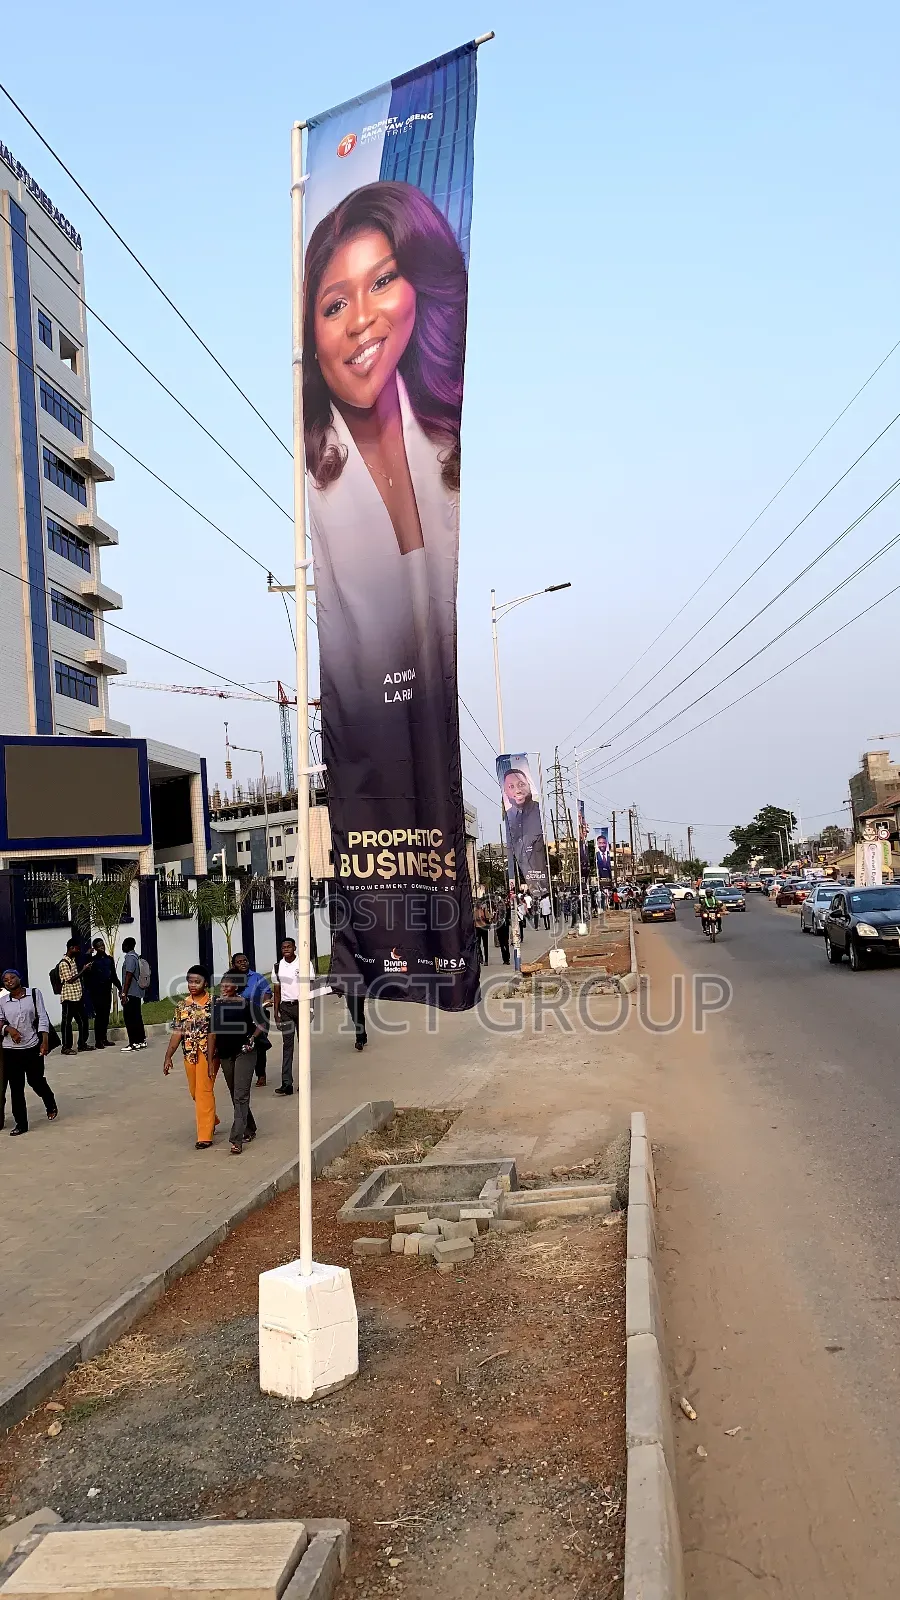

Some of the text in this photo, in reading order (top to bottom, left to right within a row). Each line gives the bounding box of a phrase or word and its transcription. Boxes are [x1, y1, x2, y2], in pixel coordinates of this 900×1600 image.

[361, 112, 434, 140] NANA YAW OBENG
[362, 116, 399, 133] PROPHET
[53, 206, 82, 251] ACCRA
[383, 667, 416, 685] ADWOA
[348, 828, 443, 849] PROPHETIC
[384, 959, 408, 967] Divine
[438, 957, 466, 968] UPSA
